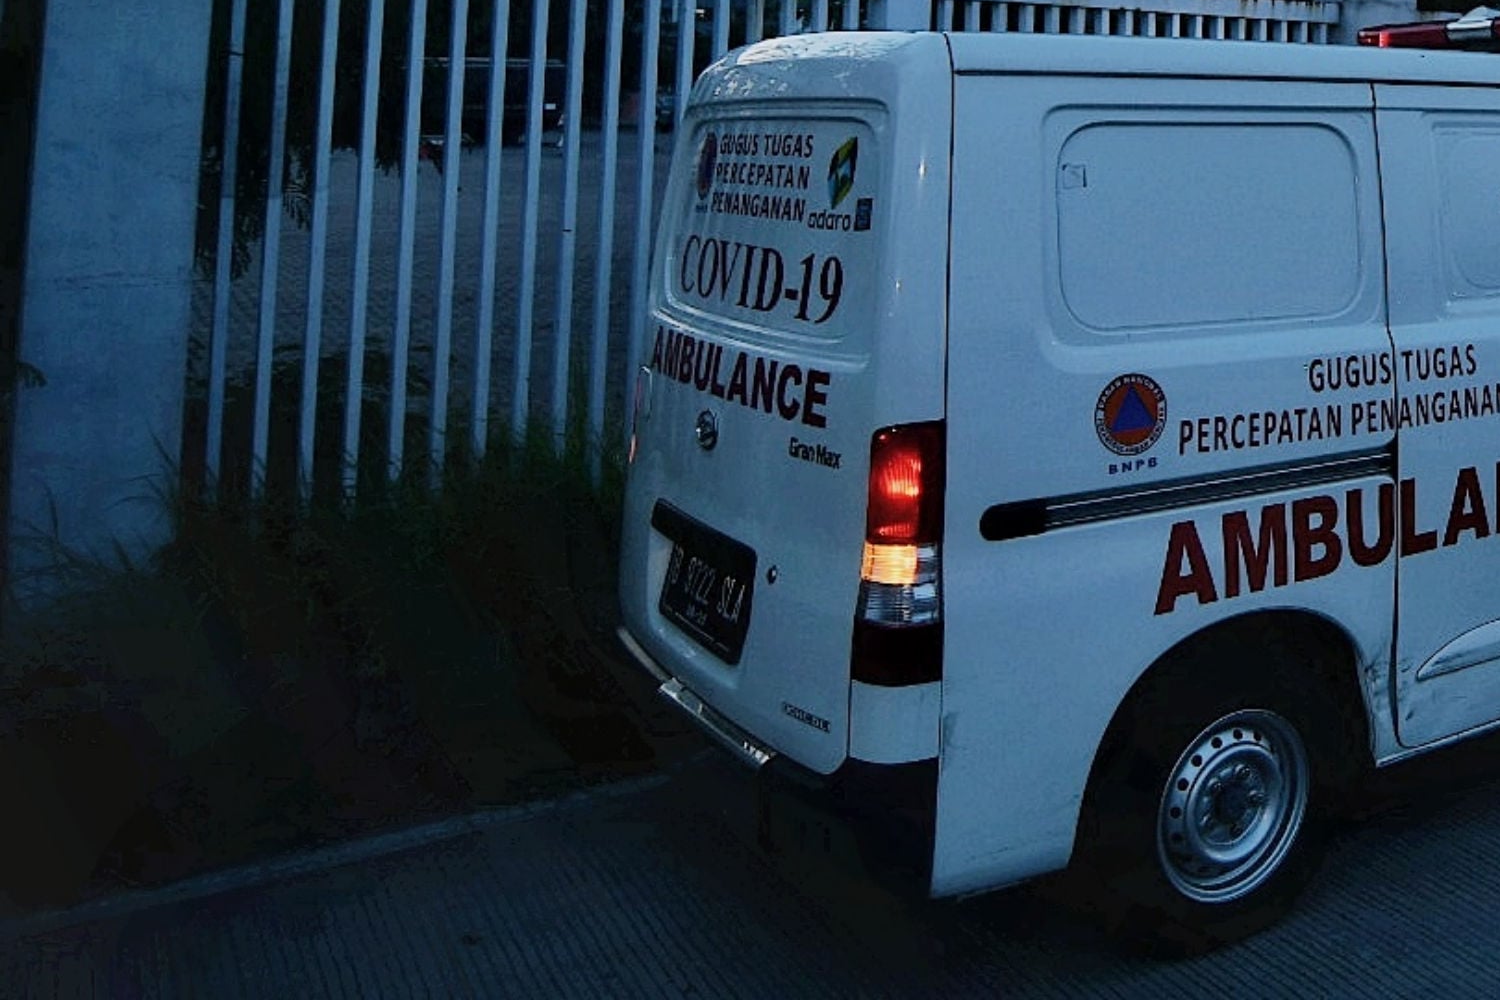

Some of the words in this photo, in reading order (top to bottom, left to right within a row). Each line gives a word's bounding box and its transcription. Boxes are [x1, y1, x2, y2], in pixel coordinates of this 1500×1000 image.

[719, 133, 759, 155] GUGUS
[763, 134, 814, 158] TUGAS
[715, 162, 810, 190] PERCEPATAN
[710, 191, 807, 223] PENANGANAN
[807, 210, 852, 231] adaro
[680, 234, 844, 324] COVID-19
[652, 325, 831, 429] AMBULANCE
[1308, 351, 1392, 393] GUGUS
[1401, 344, 1478, 383] TUGAS
[1179, 404, 1342, 455] PERCEPATAN
[789, 437, 815, 460] Gran
[816, 443, 842, 469] Max
[1108, 457, 1158, 475] BNPB
